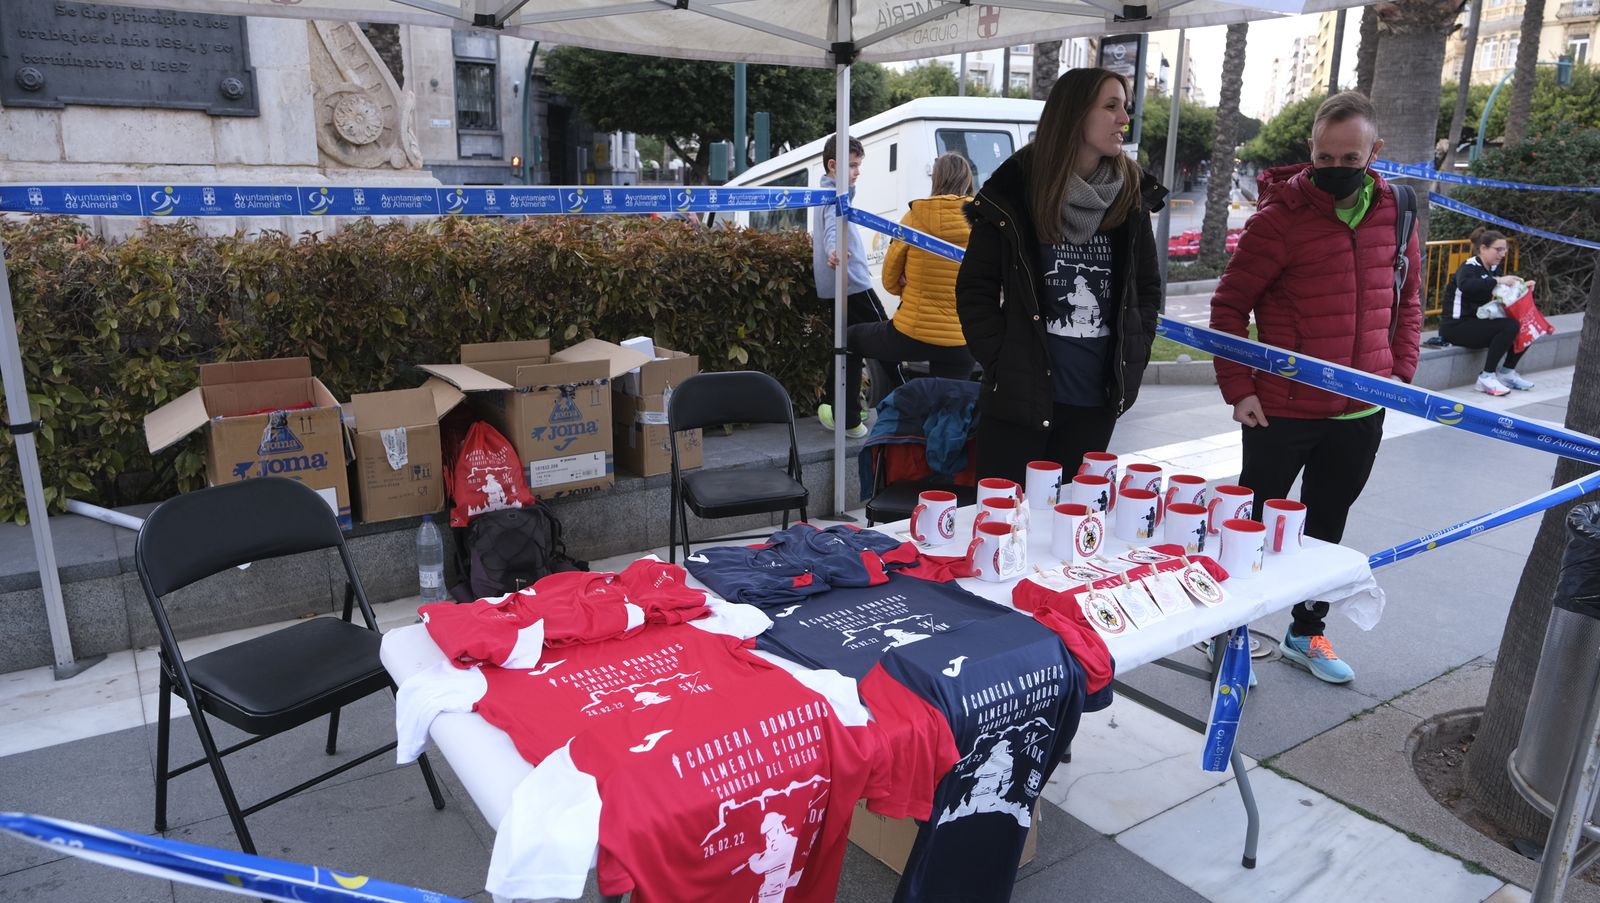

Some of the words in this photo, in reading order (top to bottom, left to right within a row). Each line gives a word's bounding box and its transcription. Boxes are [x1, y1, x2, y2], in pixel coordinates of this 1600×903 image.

[55, 5, 78, 17] Se
[111, 9, 188, 30] principio
[192, 19, 203, 29] a
[205, 16, 230, 30] los
[17, 28, 98, 46] trabajos
[103, 33, 117, 44] el
[121, 33, 151, 48] año
[200, 43, 210, 55] y
[214, 44, 234, 54] se
[21, 52, 127, 71] terminaron
[130, 59, 145, 71] el
[151, 60, 191, 74] 1897
[64, 193, 132, 204] Ayuntamiento
[234, 193, 293, 203] Ayuntamiento
[235, 200, 246, 208] de
[381, 194, 432, 203] Ayuntamiento
[510, 194, 556, 203] Ayuntamiento
[625, 193, 667, 202] Ayuntamiento
[1088, 246, 1111, 254] CIUDA
[1537, 433, 1553, 444] de
[809, 608, 854, 625] CARRERA
[869, 602, 907, 616] CIUDAD
[560, 664, 616, 684] CARRERA
[622, 643, 685, 667] BOMBEROS
[633, 655, 680, 673] CIUDAD
[629, 671, 648, 682] DEL
[970, 680, 1015, 710] CARRERA
[1025, 684, 1059, 706] CIUDAD
[585, 701, 626, 717] 26.02.22
[686, 727, 752, 769] CARRERA
[759, 700, 829, 738] BOMBEROS
[772, 725, 823, 757] CIUDAD
[766, 761, 785, 779] DEL
[703, 832, 746, 860] 26.02.22
